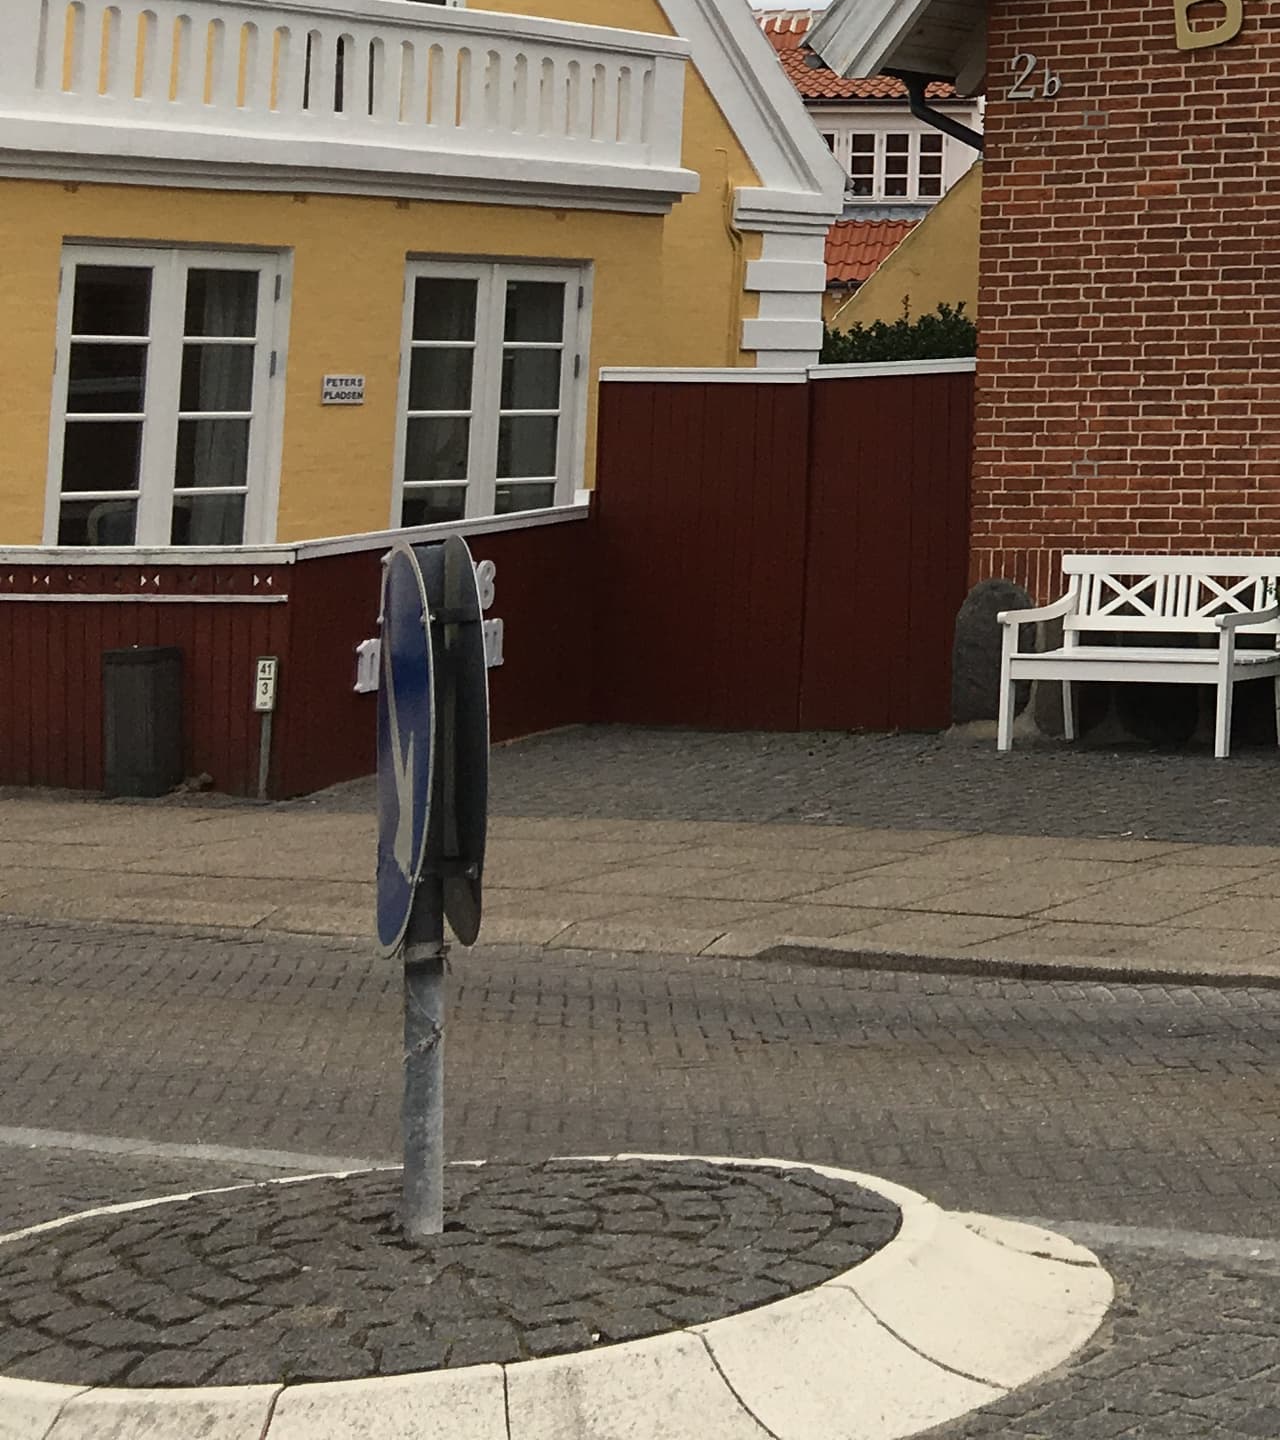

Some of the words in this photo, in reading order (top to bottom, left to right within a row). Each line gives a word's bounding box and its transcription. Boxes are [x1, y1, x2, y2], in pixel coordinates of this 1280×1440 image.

[326, 378, 363, 387] PETERS
[323, 391, 363, 400] PLADSEN
[260, 663, 272, 675] 41
[262, 682, 269, 696] 3
